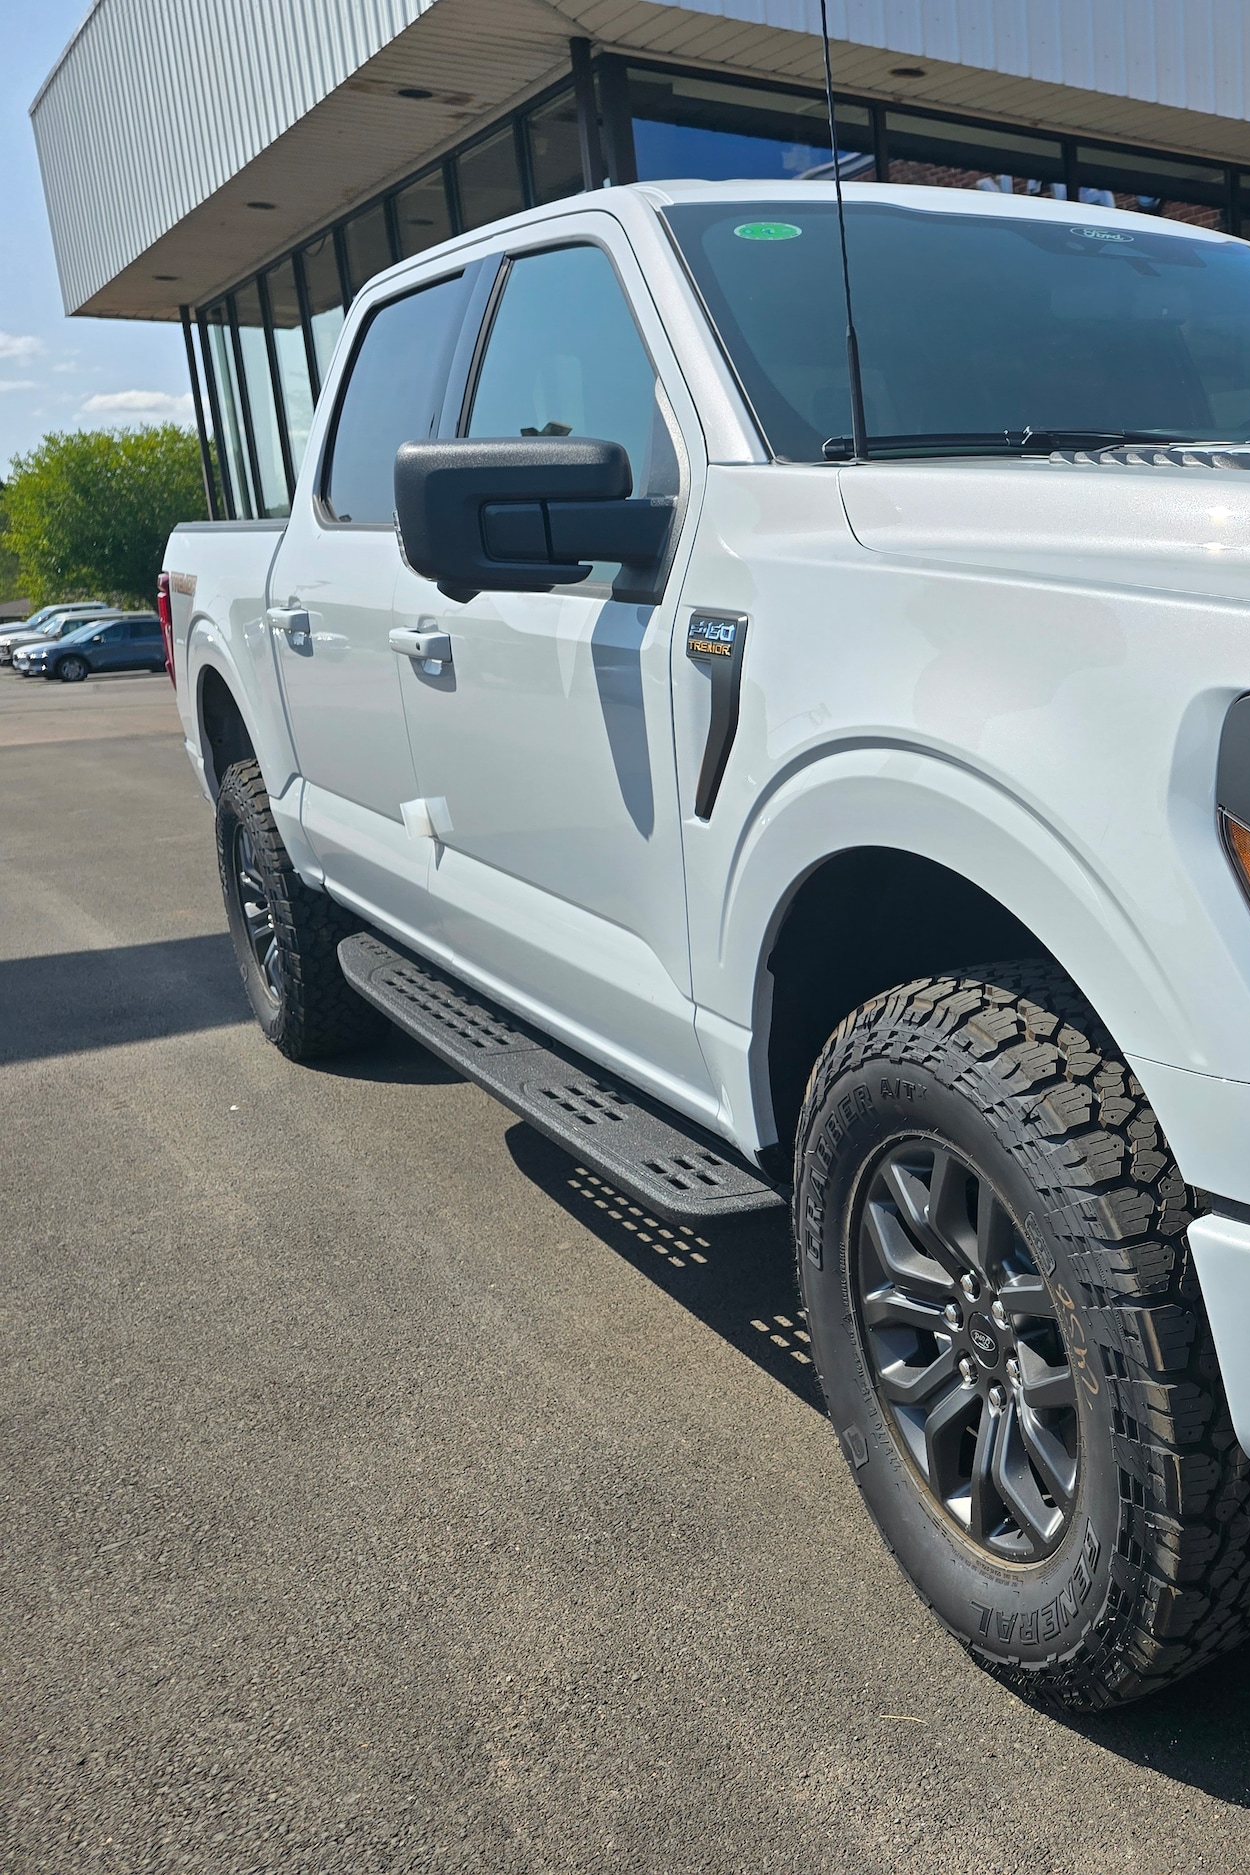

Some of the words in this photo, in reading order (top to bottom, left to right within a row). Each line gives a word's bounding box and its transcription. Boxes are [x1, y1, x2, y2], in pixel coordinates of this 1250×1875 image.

[1083, 227, 1125, 241] Ford
[690, 621, 736, 641] F-150
[688, 639, 732, 656] TREMOR
[804, 1081, 875, 1271] GRABBER
[973, 1331, 991, 1350] Ford
[970, 1516, 1101, 1645] GENERAL
